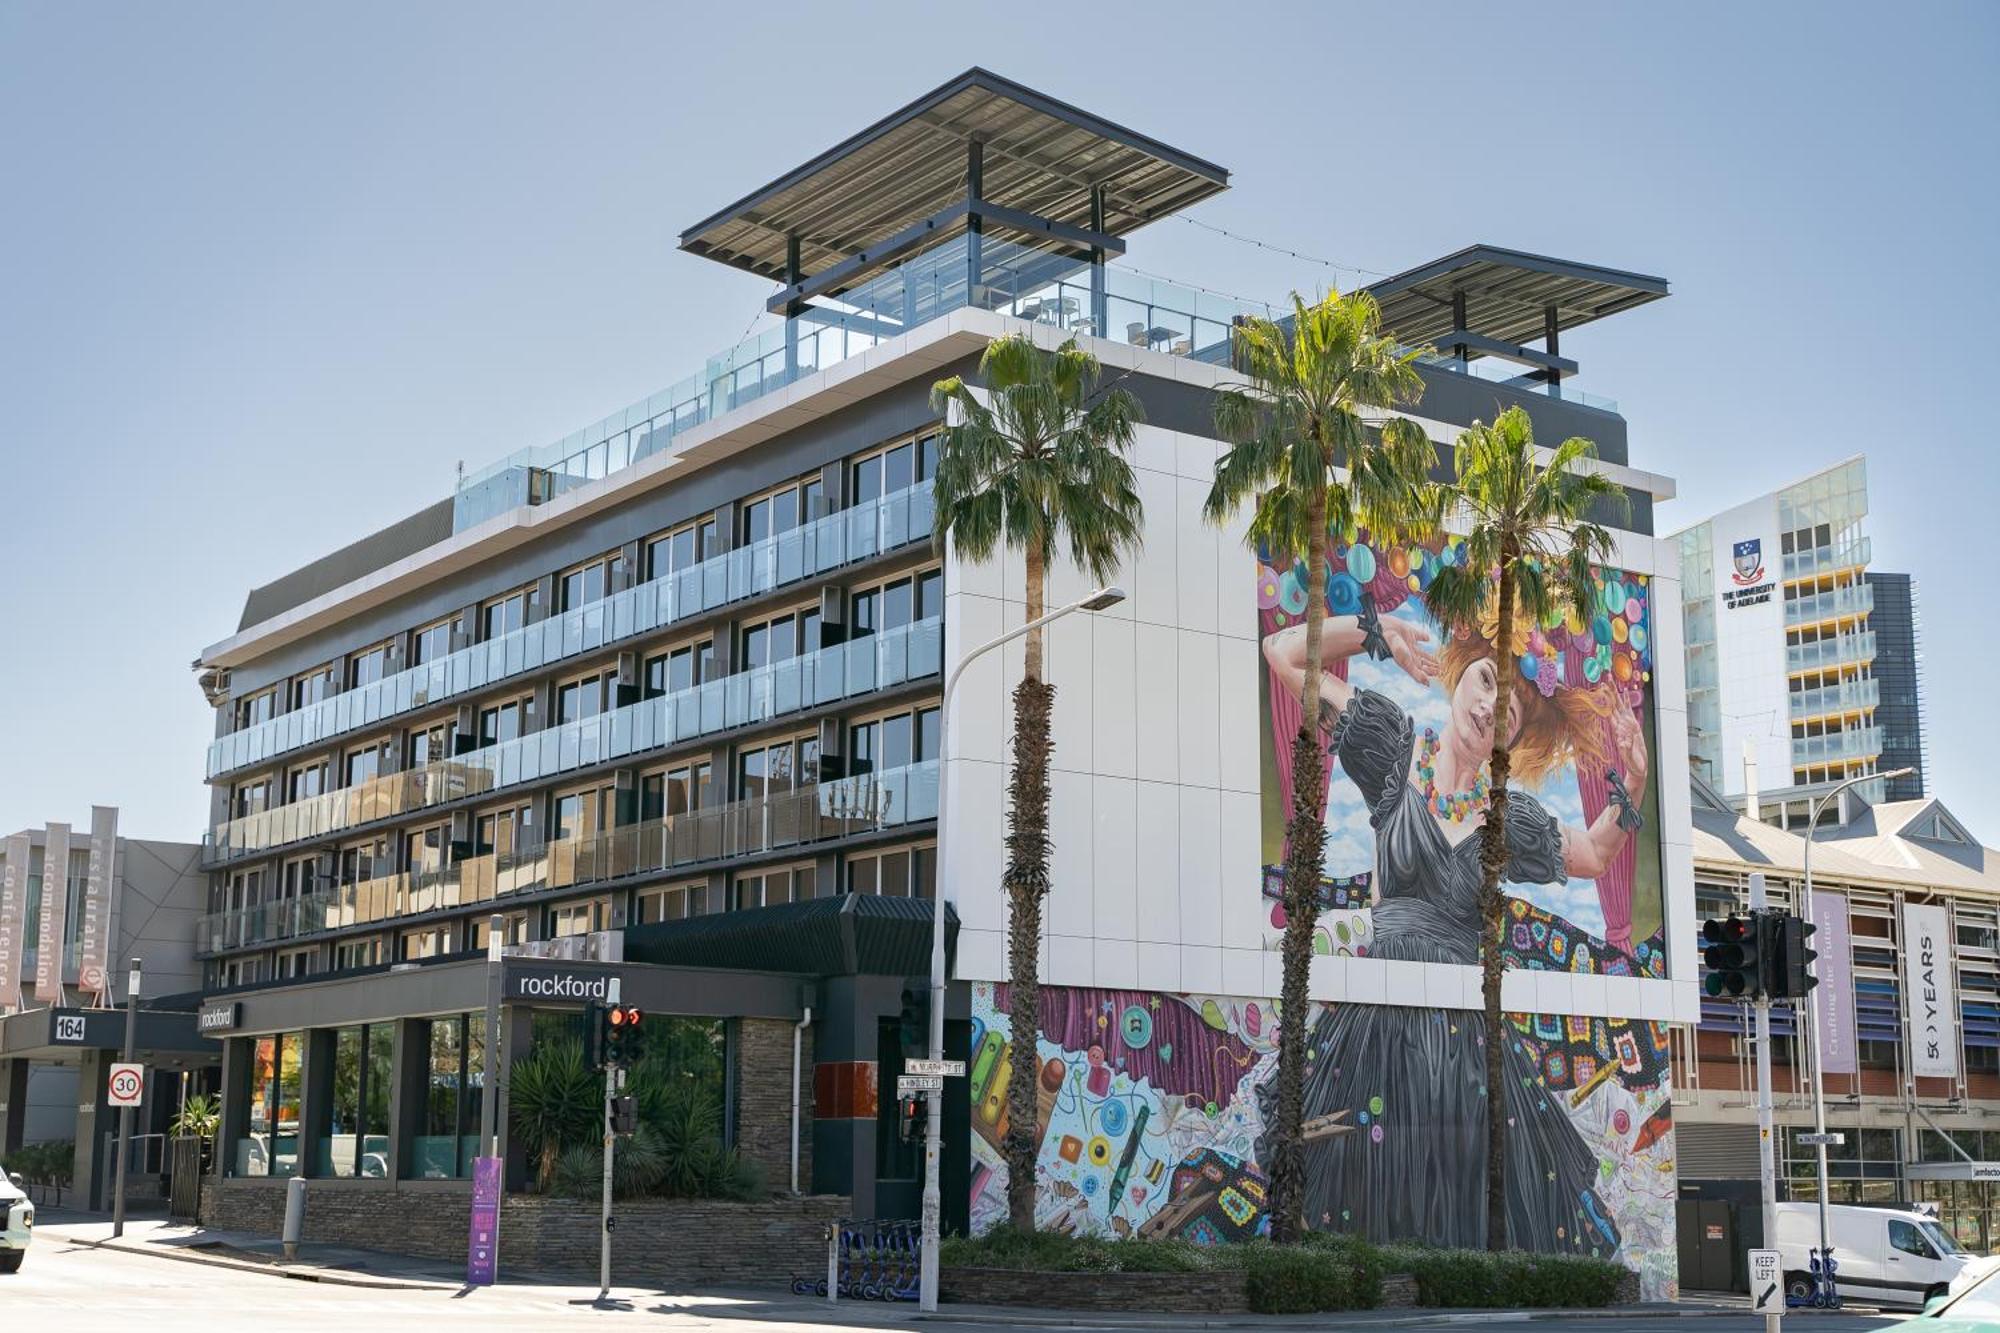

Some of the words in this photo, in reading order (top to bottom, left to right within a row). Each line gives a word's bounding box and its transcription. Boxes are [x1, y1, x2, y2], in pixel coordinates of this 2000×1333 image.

[83, 838, 101, 960] restaurant
[1823, 911, 1833, 960] Future
[520, 974, 605, 997] rockford
[1920, 936, 1938, 1020] YEARS
[202, 1007, 231, 1028] rockford
[58, 1019, 83, 1038] 164
[116, 1078, 136, 1091] 30
[1755, 1256, 1775, 1267] KEEP
[1756, 1269, 1775, 1280] LEFT
